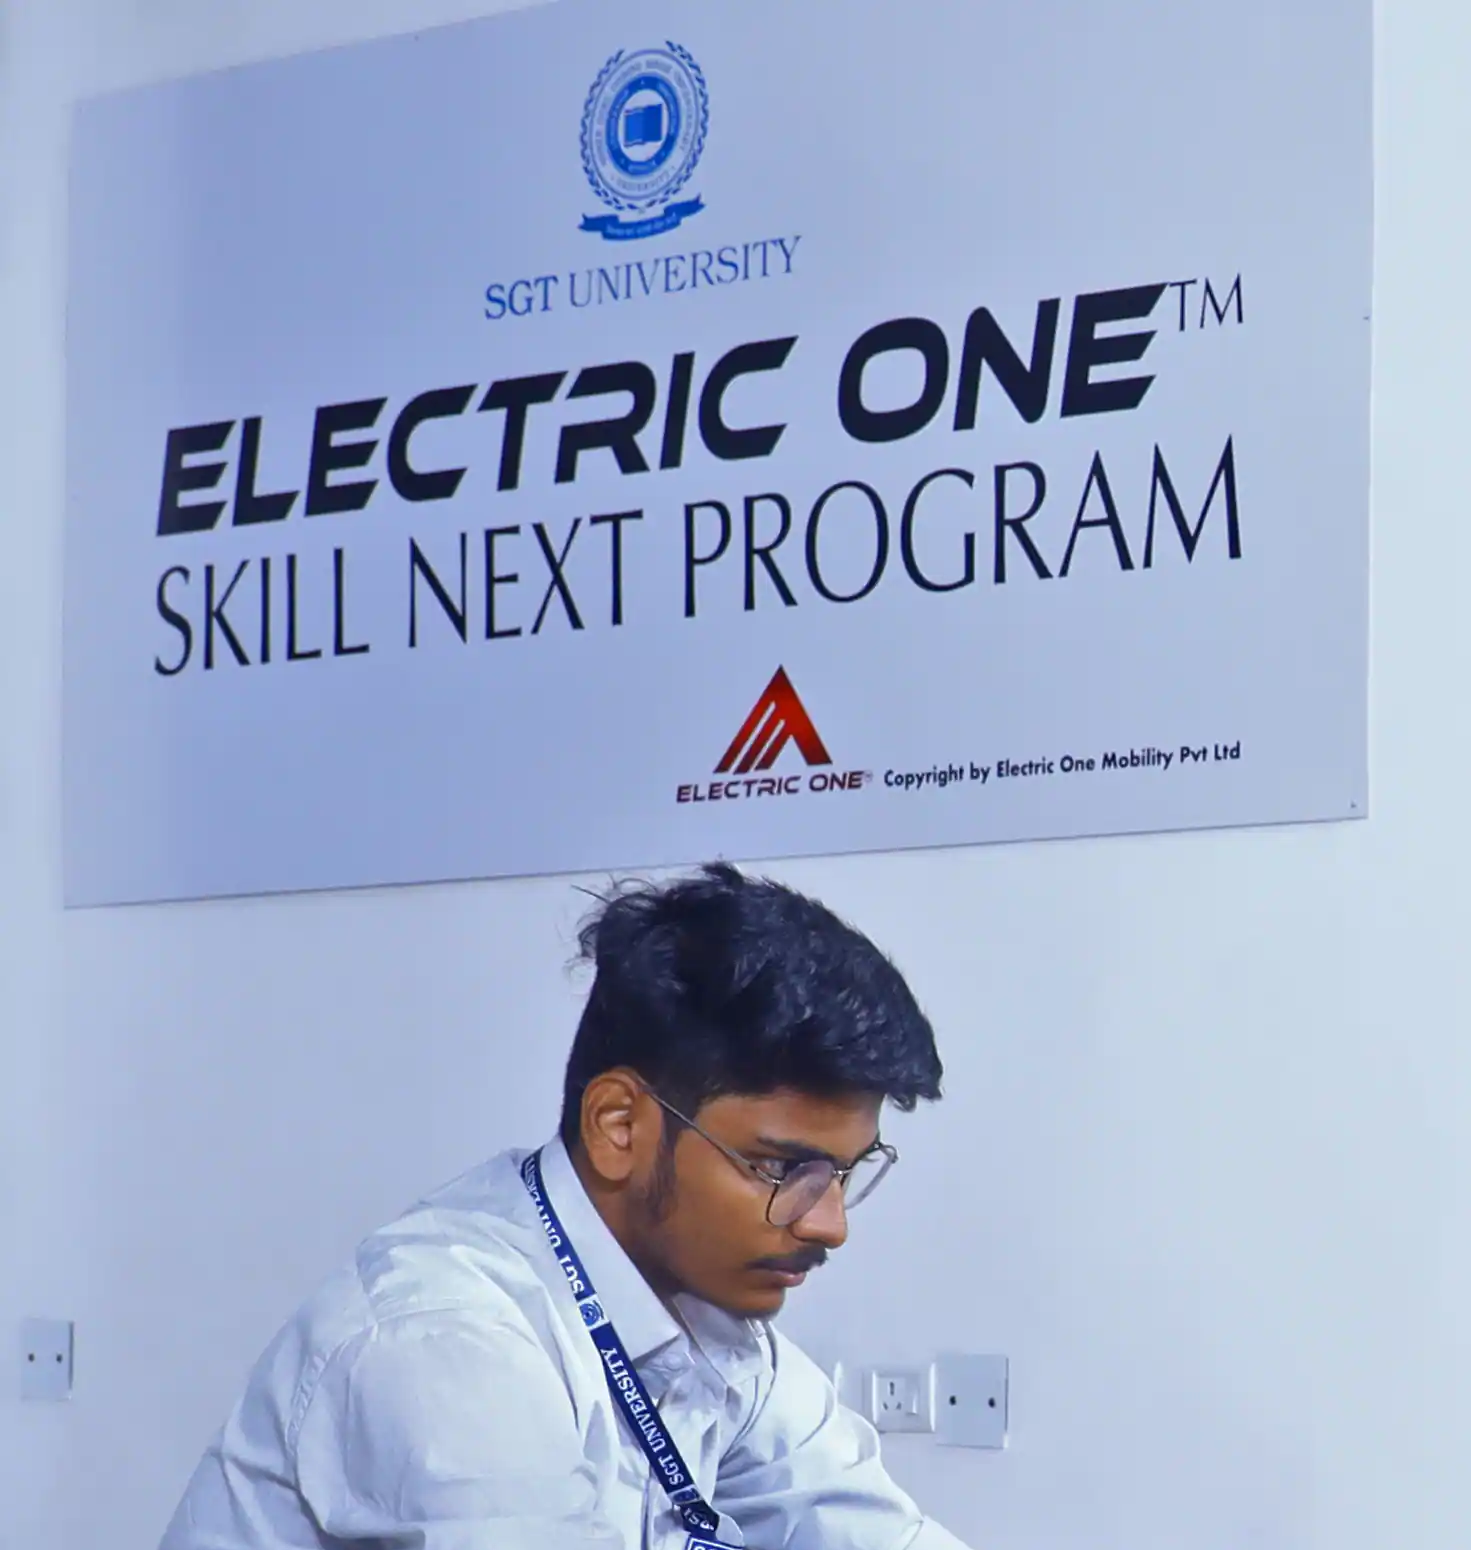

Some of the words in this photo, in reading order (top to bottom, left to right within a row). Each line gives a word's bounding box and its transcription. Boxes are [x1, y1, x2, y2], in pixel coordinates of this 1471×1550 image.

[484, 274, 559, 320] SGT
[568, 234, 803, 308] UNIVERSITY
[155, 335, 800, 537] ELECTRIC
[837, 282, 1170, 443] ONE
[154, 547, 370, 677] SKILL
[408, 508, 644, 649] NEXT
[683, 435, 1242, 618] PROGRAM
[676, 776, 801, 804] ELECTRIC
[808, 770, 865, 792] ONE
[883, 763, 965, 791] Copyright
[969, 761, 991, 784] by
[996, 758, 1054, 778] Electric
[1059, 754, 1096, 773] One
[1101, 746, 1174, 770] Mobility
[1180, 746, 1208, 763] Pvt
[1214, 740, 1241, 761] Ltd
[600, 1347, 667, 1453] UNIVERSITY
[657, 1453, 685, 1486] SGT
